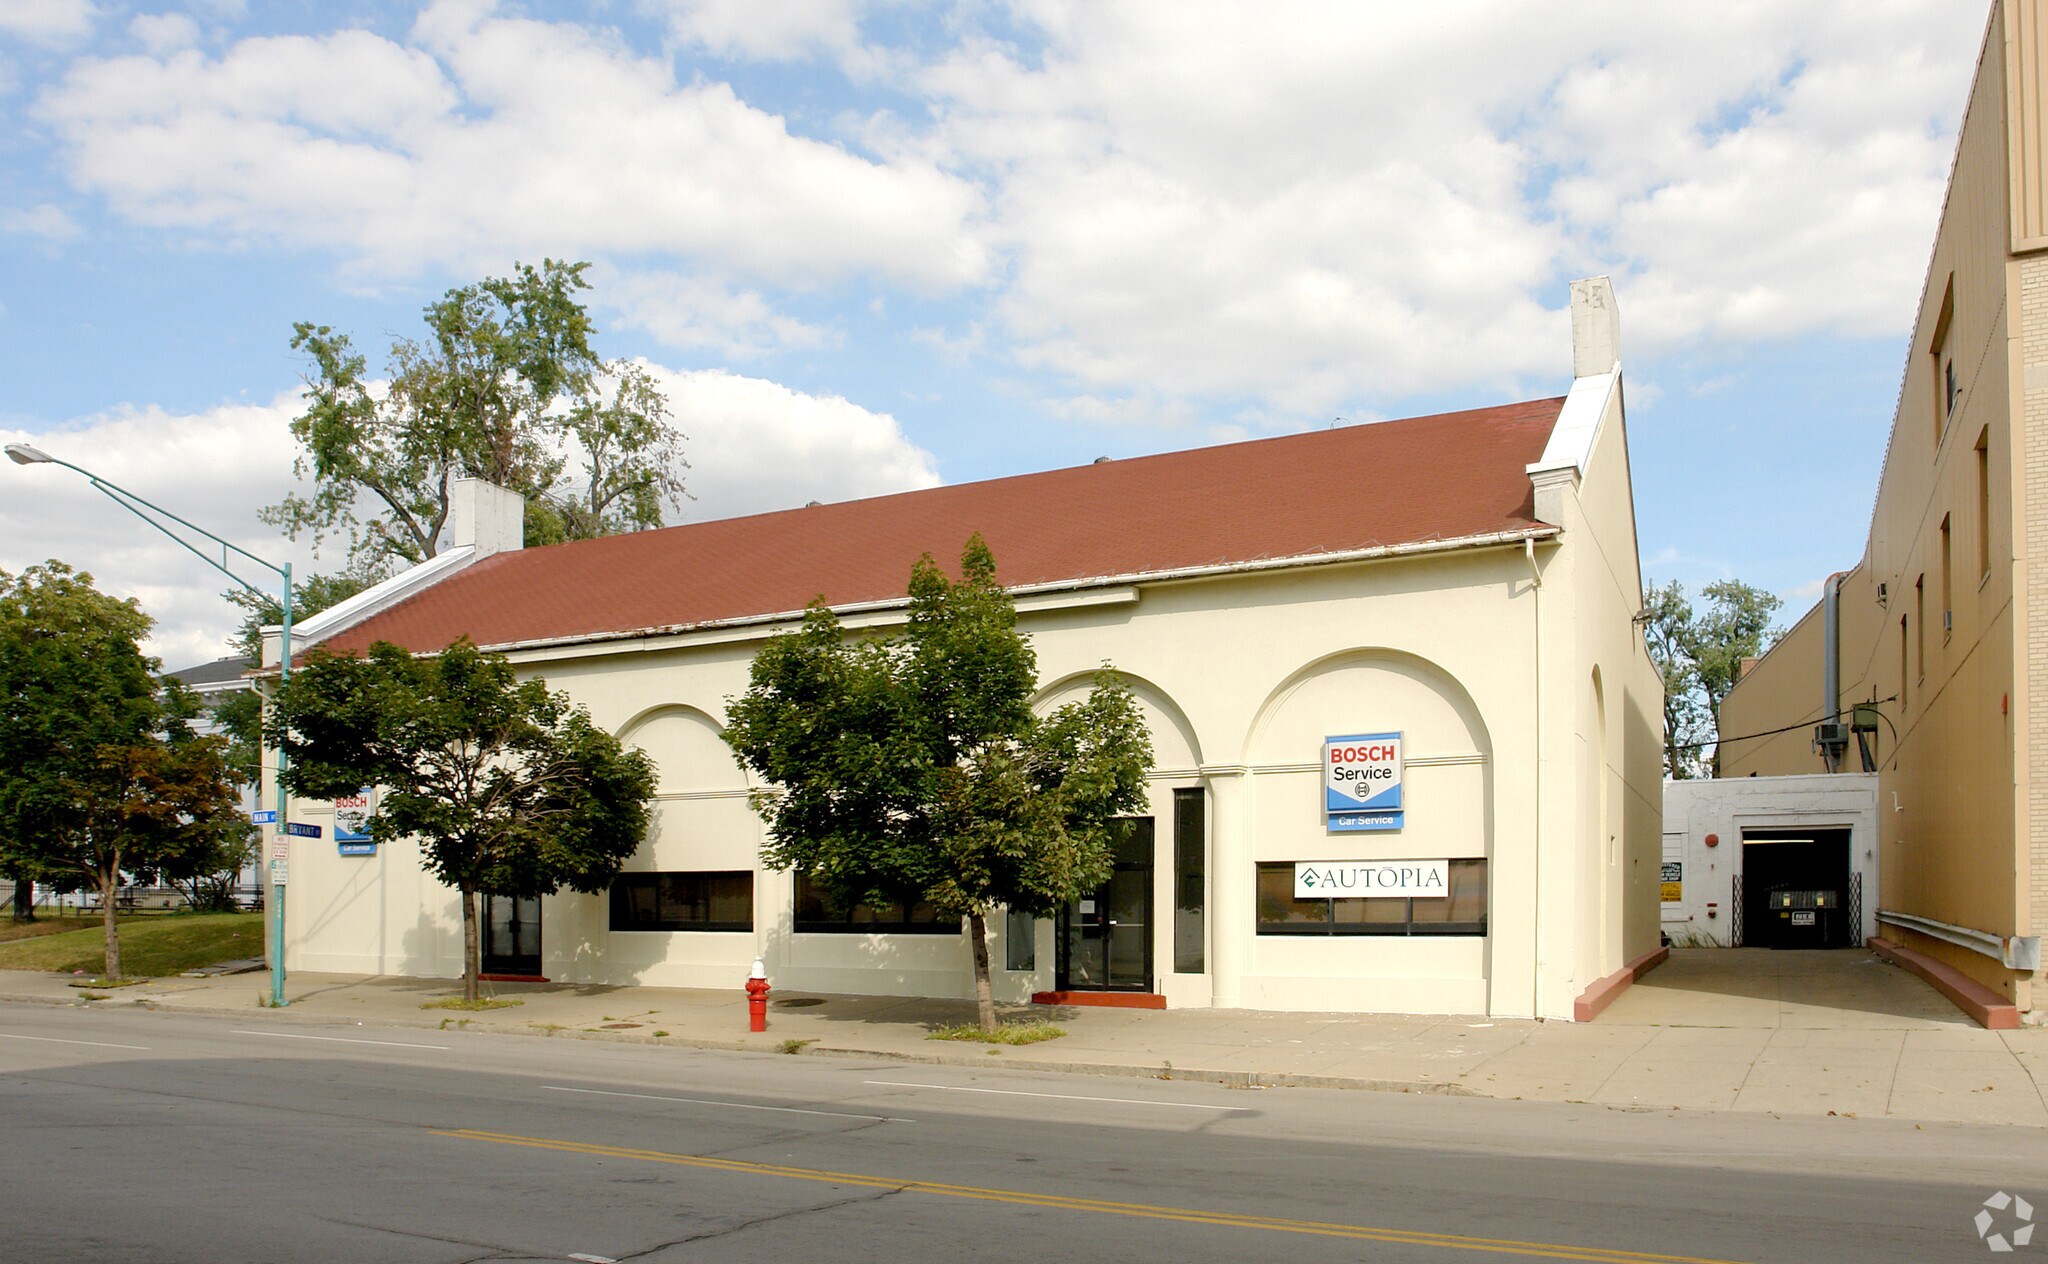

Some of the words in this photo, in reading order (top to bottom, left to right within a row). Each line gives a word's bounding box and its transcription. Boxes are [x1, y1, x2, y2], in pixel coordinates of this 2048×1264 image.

[1331, 746, 1394, 763] BOSCH
[1334, 766, 1392, 780] Service
[335, 797, 367, 808] BOSCH
[254, 812, 269, 822] MAIN
[1338, 817, 1355, 825] Car
[1358, 816, 1394, 825] Service
[289, 824, 315, 837] BRYANT
